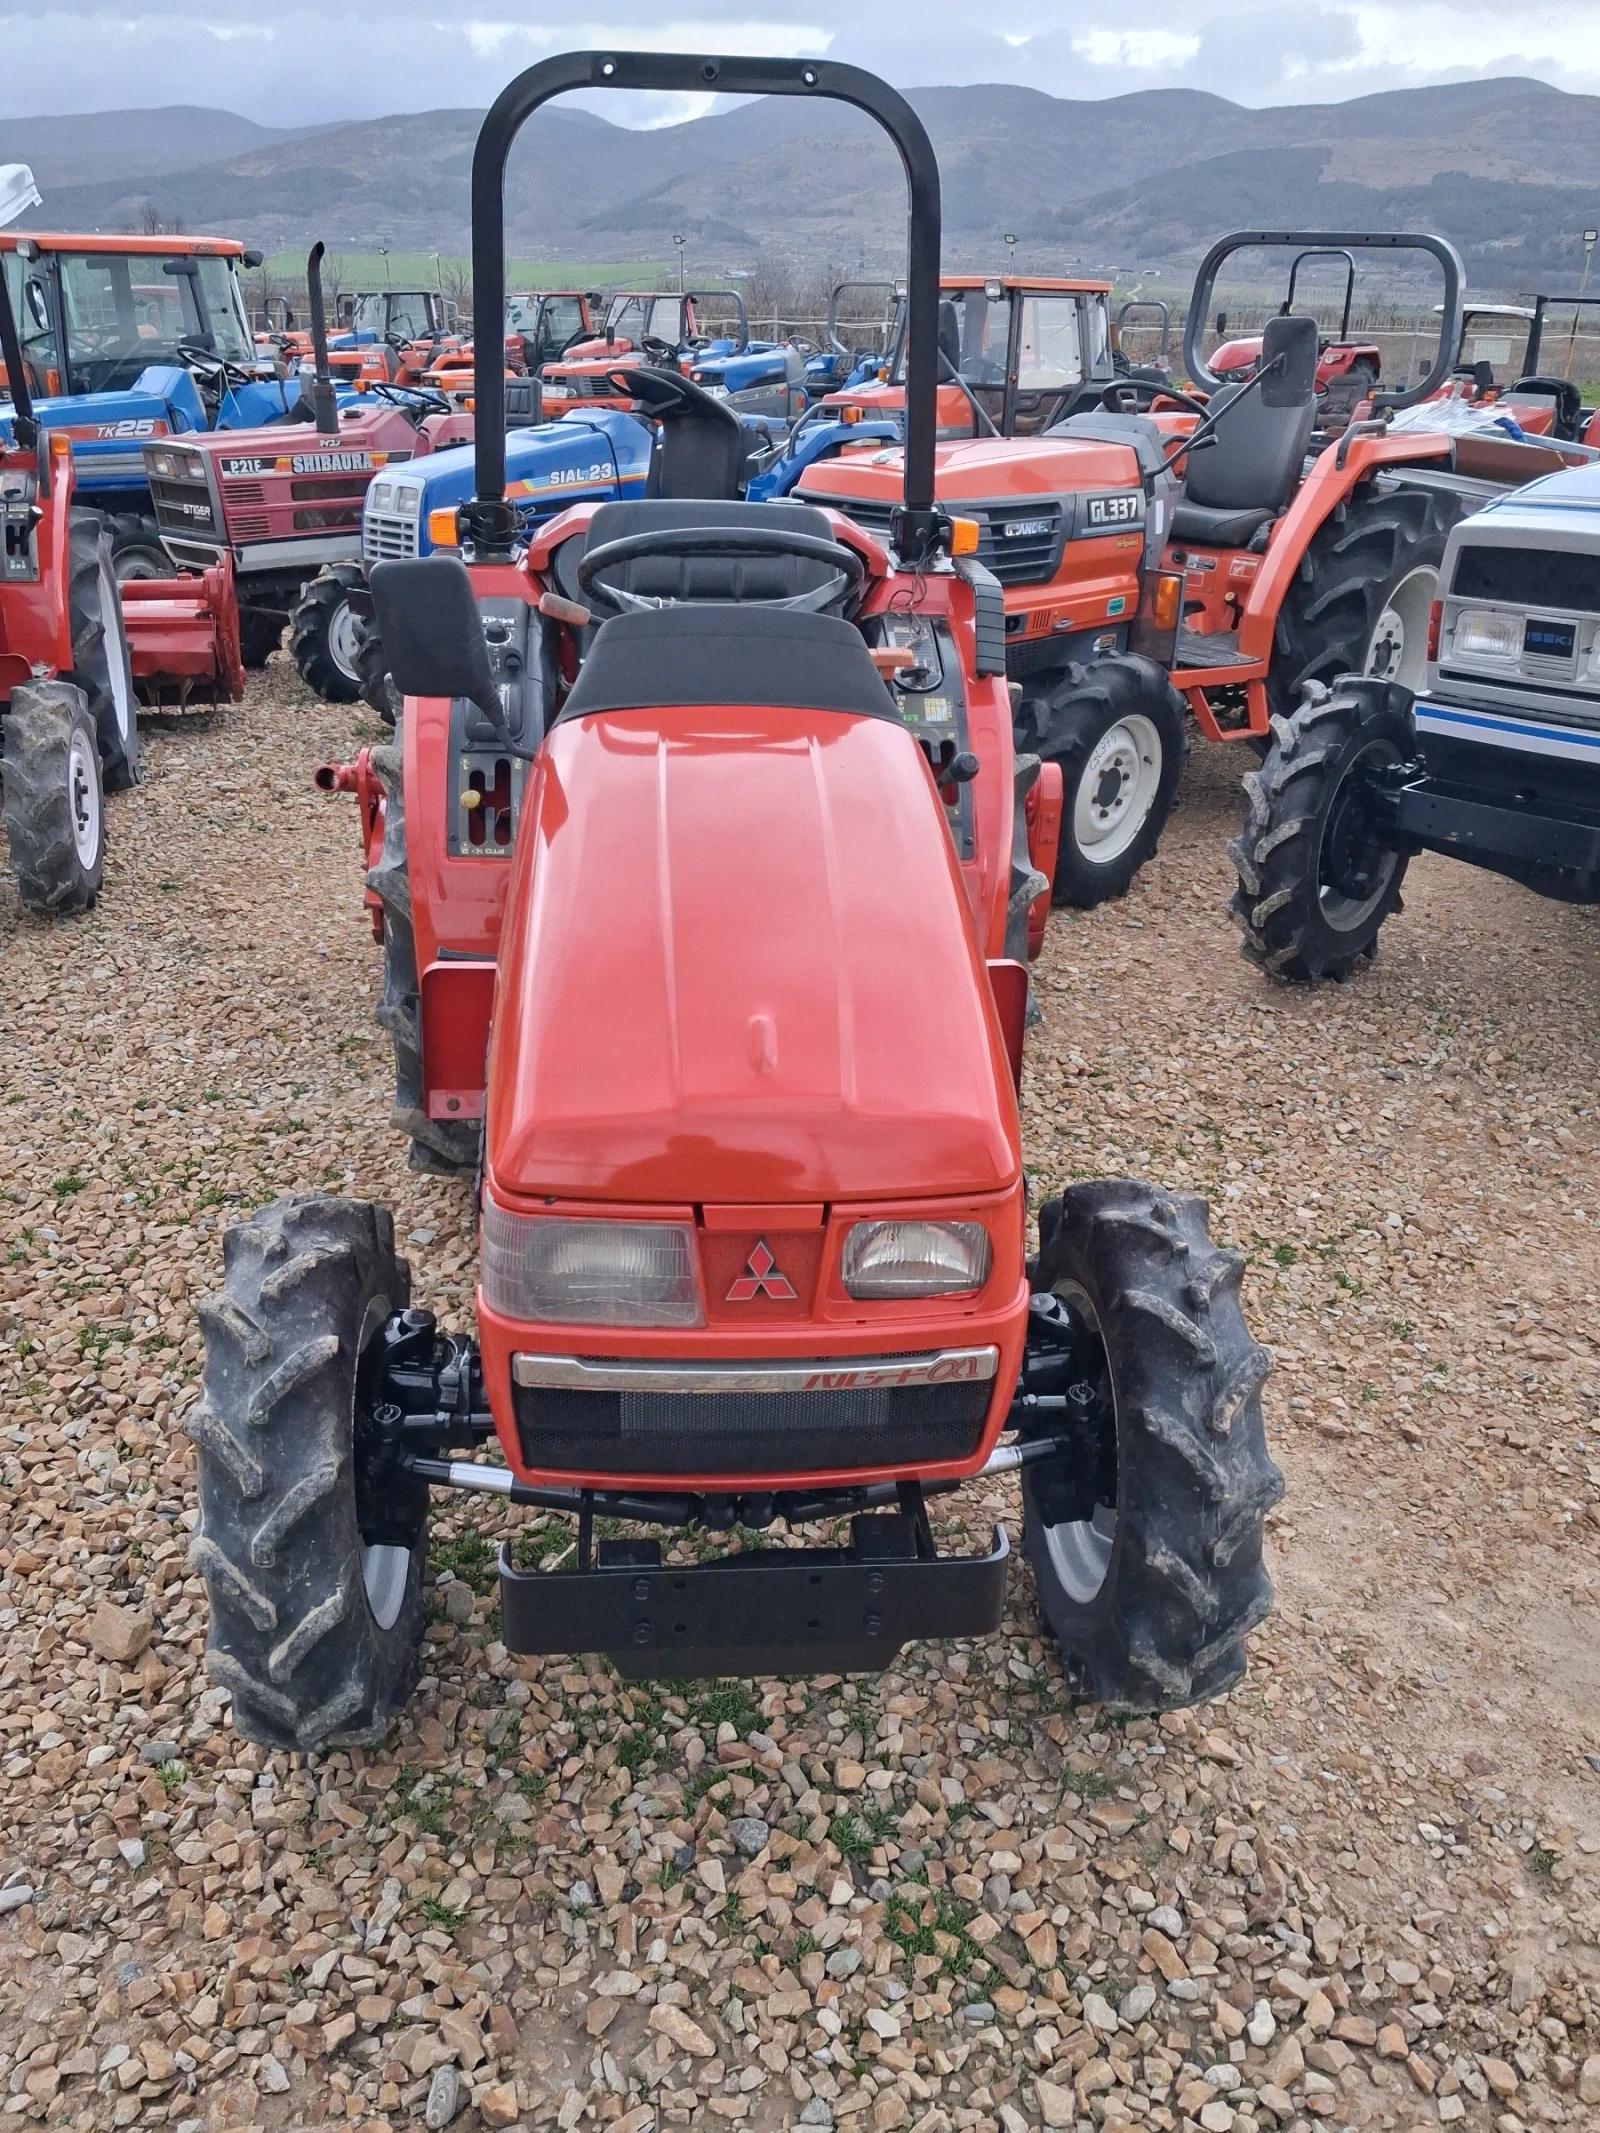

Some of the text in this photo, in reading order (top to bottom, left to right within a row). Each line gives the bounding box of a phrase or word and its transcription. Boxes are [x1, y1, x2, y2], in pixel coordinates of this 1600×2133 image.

[97, 419, 155, 438] TK25
[292, 452, 373, 474] SHIBAURA
[550, 462, 612, 485] SIAL 23
[183, 503, 211, 517] STIGER
[1090, 497, 1137, 523] GL337
[1526, 631, 1573, 646] ISEKI
